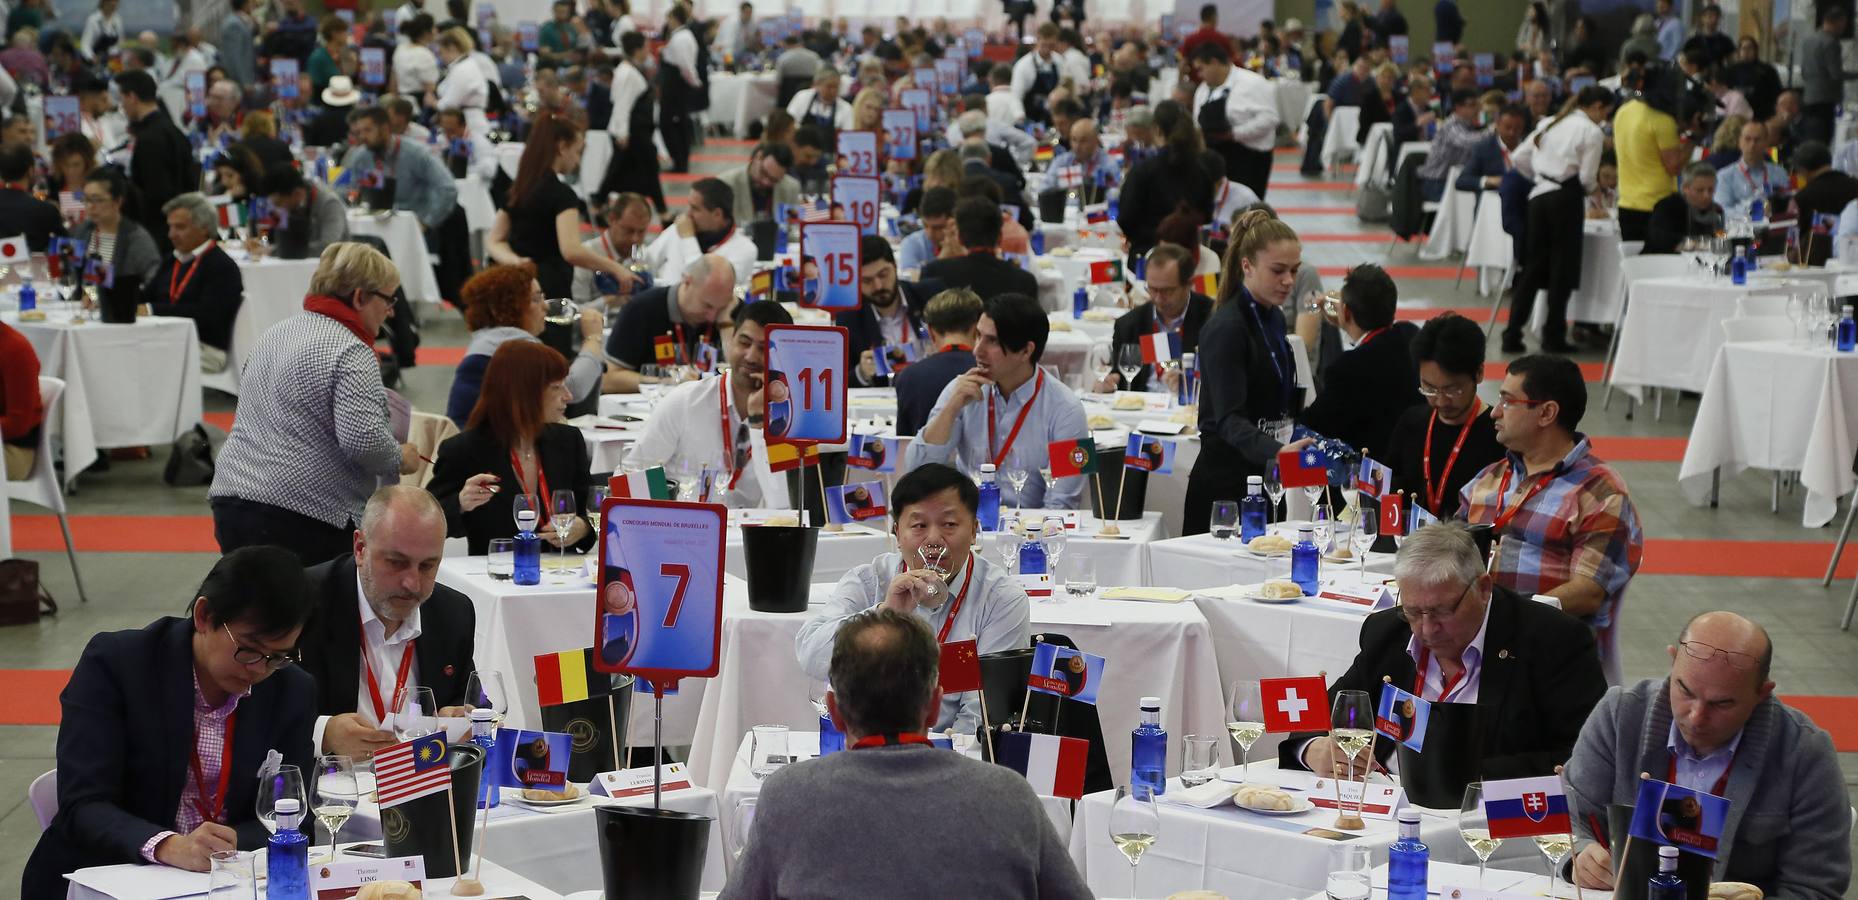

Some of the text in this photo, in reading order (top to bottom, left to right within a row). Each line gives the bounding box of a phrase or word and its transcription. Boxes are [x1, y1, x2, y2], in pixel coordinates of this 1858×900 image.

[893, 126, 911, 145] 27
[850, 151, 873, 173] 23
[850, 201, 875, 228] 19
[824, 252, 855, 287] 15
[797, 367, 833, 412] 11
[659, 562, 692, 629] 7
